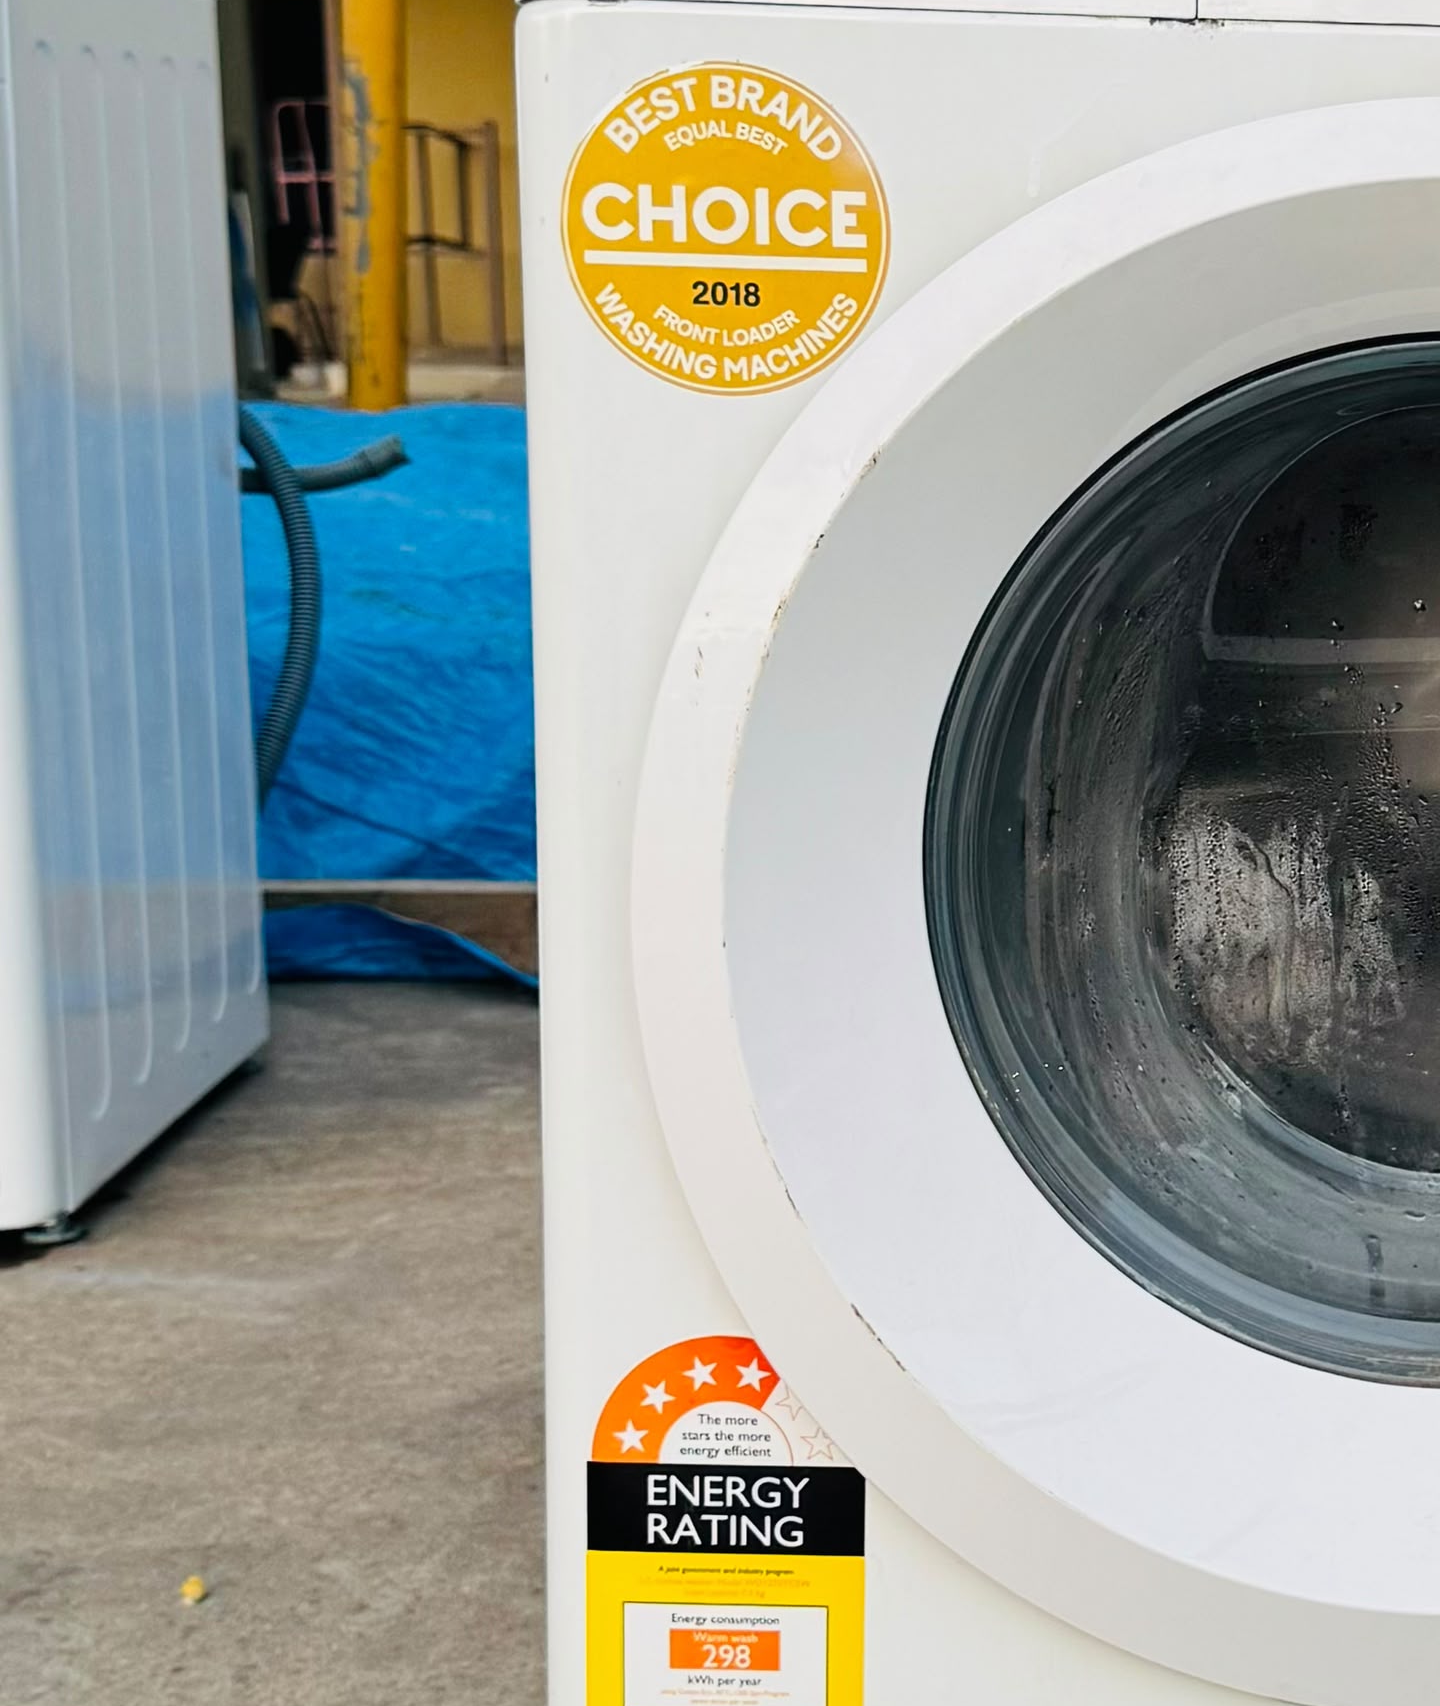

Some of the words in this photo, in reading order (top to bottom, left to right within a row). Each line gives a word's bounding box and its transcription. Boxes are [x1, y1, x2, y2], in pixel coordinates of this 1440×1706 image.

[602, 77, 698, 154] BEST
[710, 74, 842, 161] BRAND
[663, 120, 732, 152] EQUAL
[736, 121, 788, 156] BEST
[581, 182, 868, 249] CHOICE
[692, 281, 761, 307] 2018
[594, 282, 717, 381] WASHING
[724, 293, 858, 382] MACHINES
[653, 304, 720, 345] FRONT
[722, 309, 800, 347] LOADER
[697, 1413, 722, 1426] The
[725, 1415, 758, 1427] more
[682, 1430, 711, 1442] stars
[715, 1430, 735, 1442] the
[738, 1432, 771, 1443] more
[680, 1447, 720, 1459] energy
[724, 1445, 772, 1458] efficient
[646, 1474, 810, 1509] ENERGY
[646, 1513, 805, 1547] RATING
[671, 1613, 708, 1626] Energy
[711, 1614, 780, 1626] consumption
[693, 1631, 728, 1643] Warm
[731, 1632, 758, 1643] wash
[702, 1644, 751, 1669] 298
[687, 1675, 714, 1686] kWh
[718, 1677, 736, 1688] per
[740, 1677, 762, 1688] year
